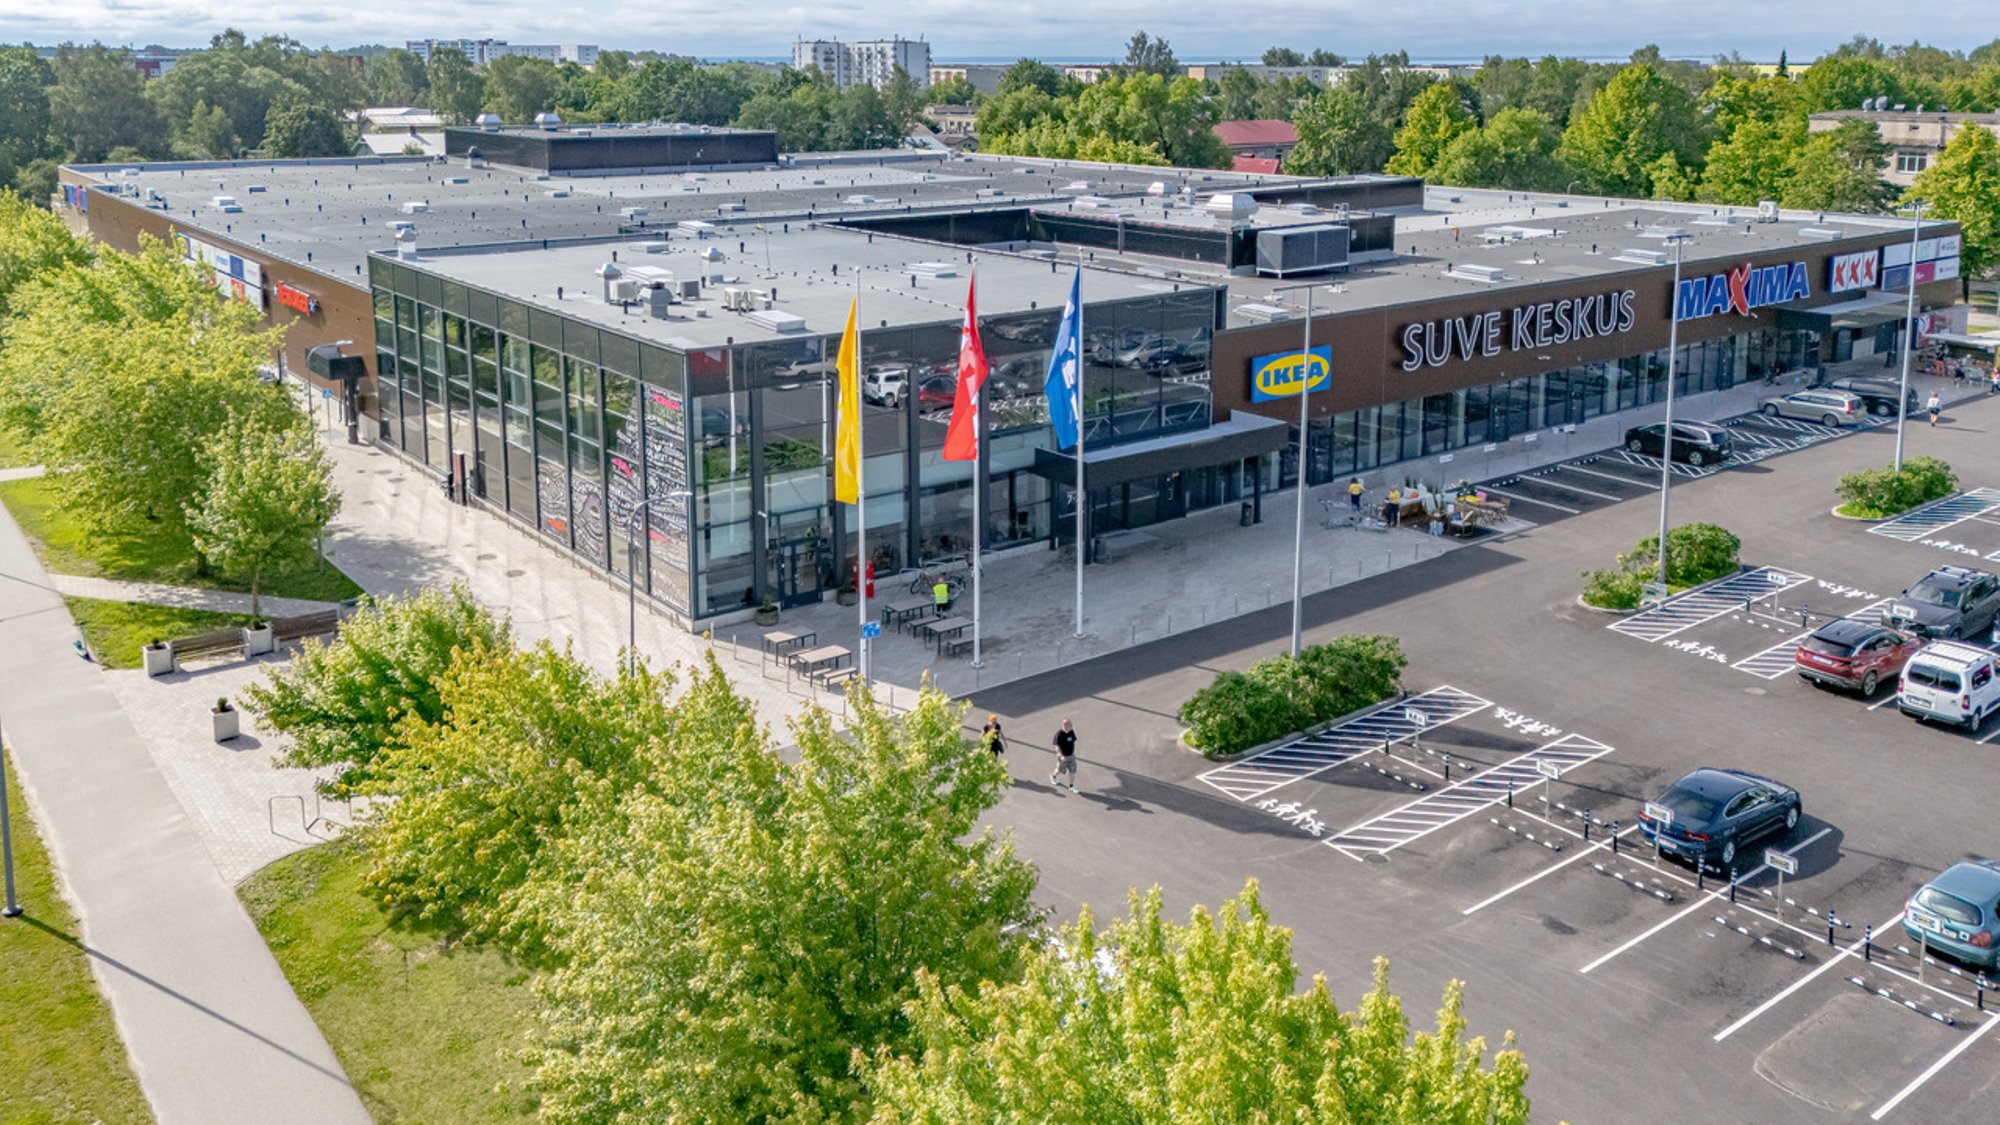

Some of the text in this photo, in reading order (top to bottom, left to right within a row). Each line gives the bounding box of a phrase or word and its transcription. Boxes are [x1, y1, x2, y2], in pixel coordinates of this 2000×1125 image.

[1677, 262, 1810, 322] MAXIMA
[1402, 290, 1636, 371] SUVE KESKUS
[1263, 361, 1324, 388] IKEA
